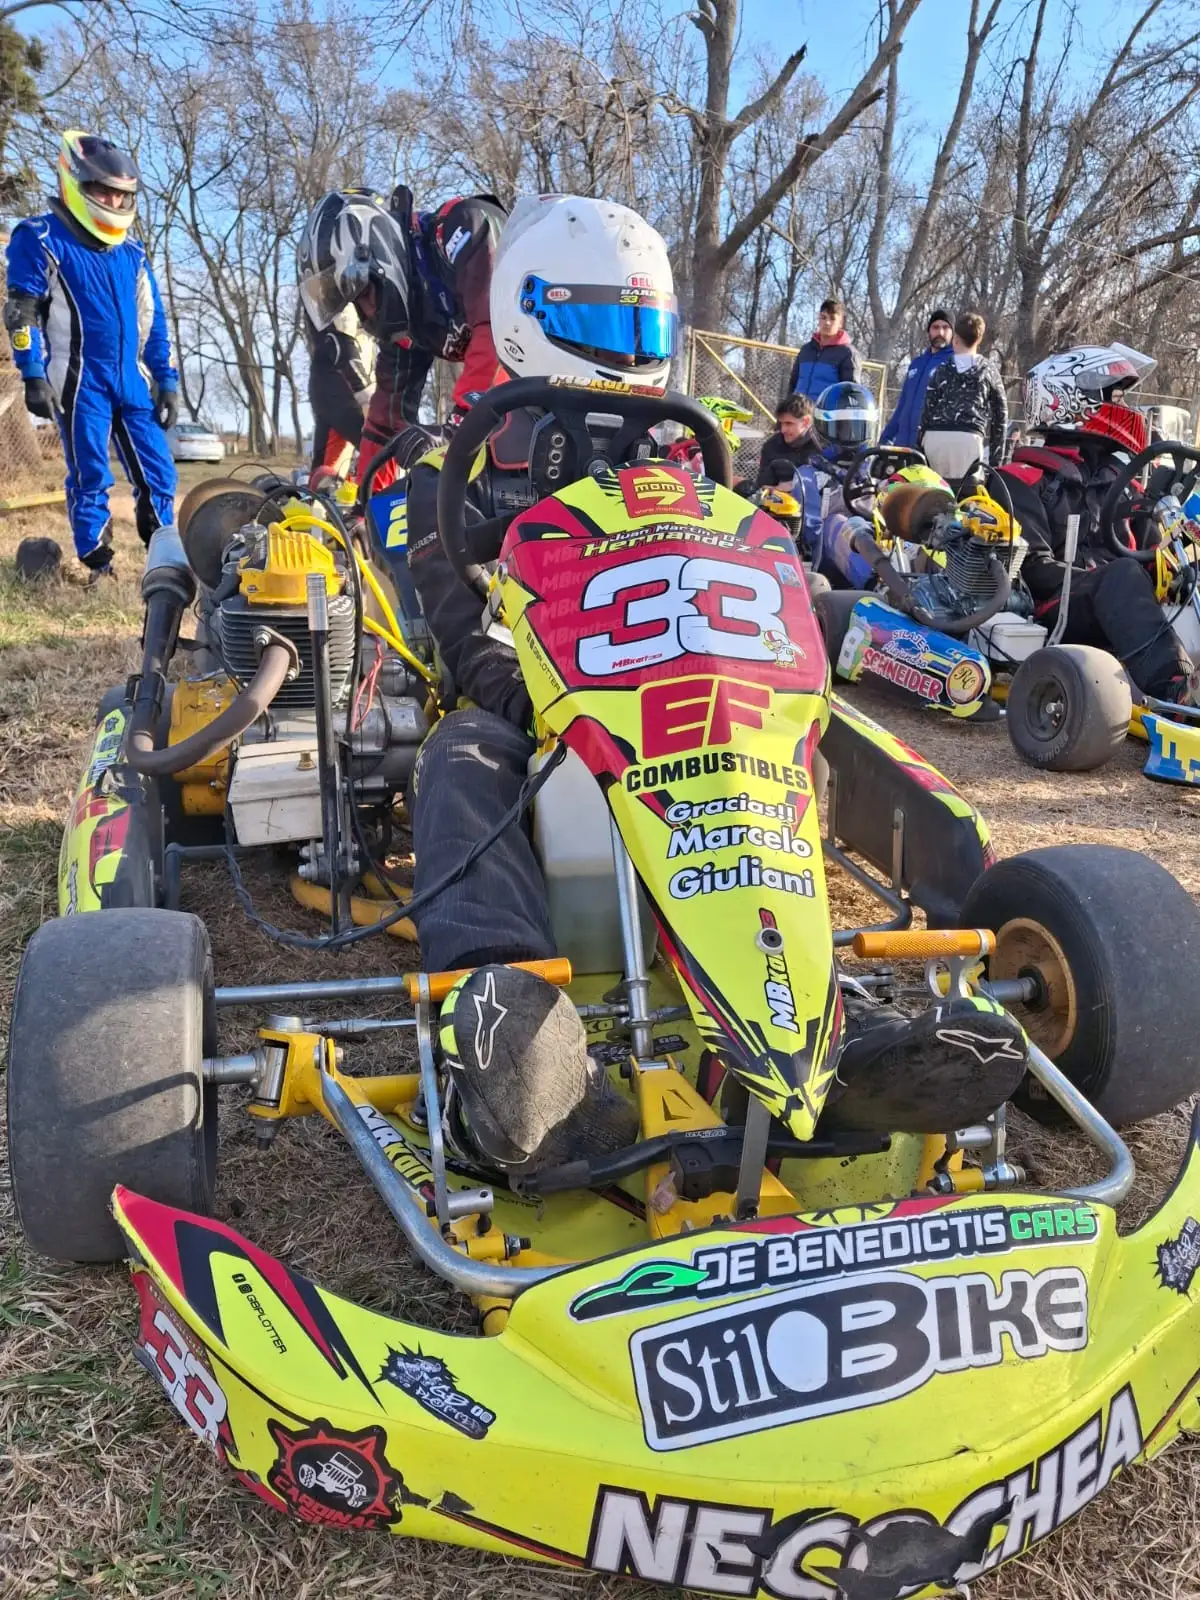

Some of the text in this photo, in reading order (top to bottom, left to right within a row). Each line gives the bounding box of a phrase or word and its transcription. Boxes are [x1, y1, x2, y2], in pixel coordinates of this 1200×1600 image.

[550, 290, 569, 299] BELL
[635, 483, 686, 493] momo
[583, 532, 752, 556] Hernandez
[609, 529, 650, 542] Juan
[576, 554, 785, 676] 33
[863, 647, 943, 702] SCHNEIDER
[641, 678, 770, 760] EF
[627, 752, 808, 793] COMBUSTIBLES
[666, 794, 795, 823] Gracias!!
[666, 825, 813, 858] Marcelo
[668, 856, 816, 900] Giuliani
[700, 1206, 1097, 1290] DE BENEDICTIS CARS
[246, 1294, 287, 1354] GBPLOTTER
[145, 1310, 227, 1448] 33
